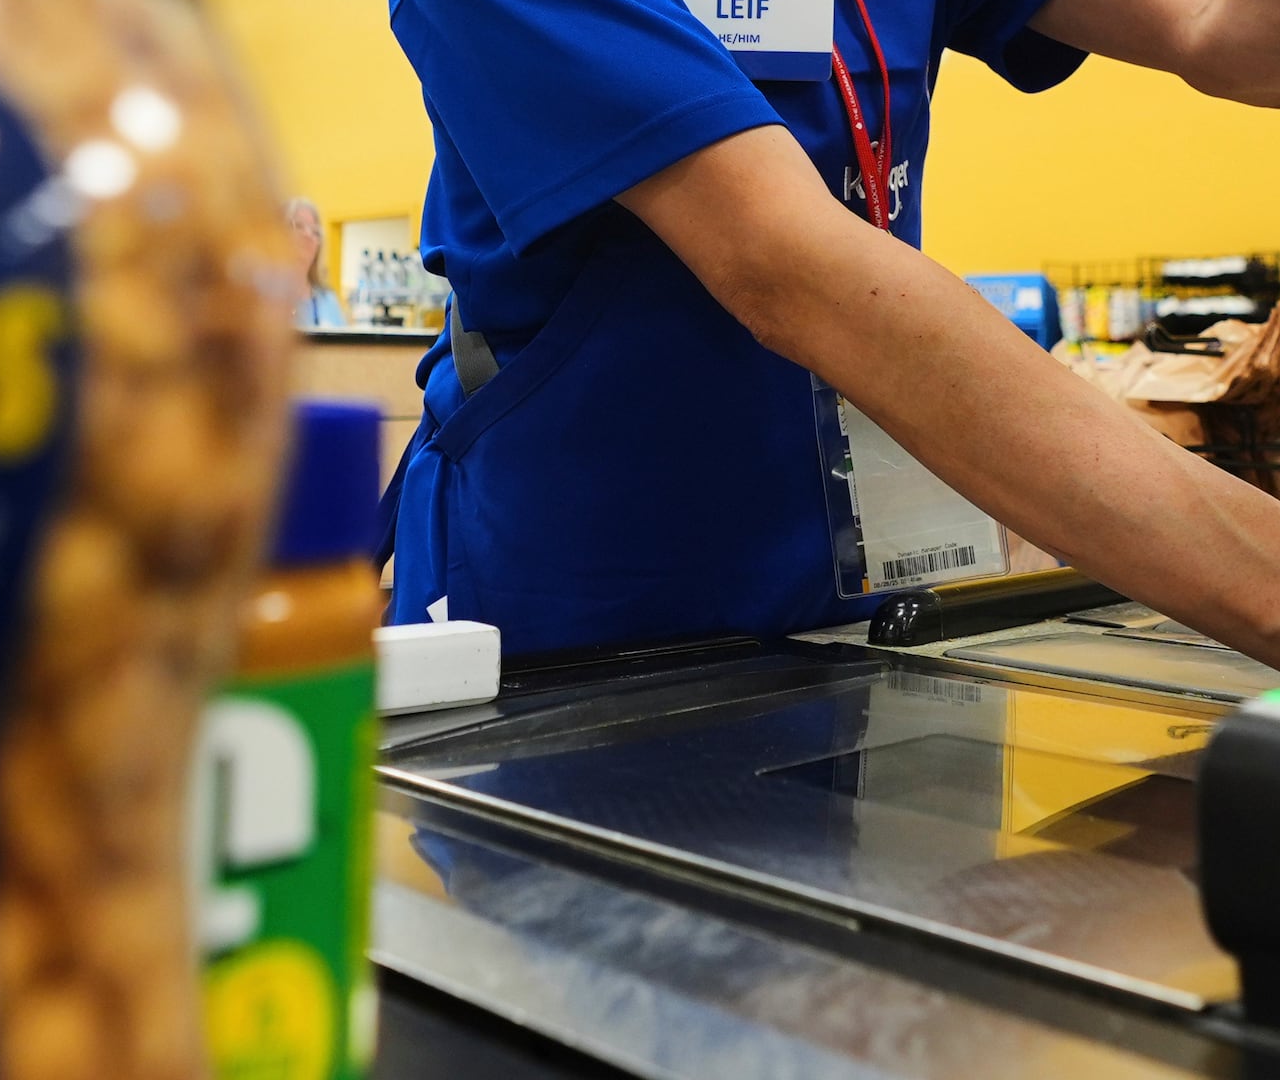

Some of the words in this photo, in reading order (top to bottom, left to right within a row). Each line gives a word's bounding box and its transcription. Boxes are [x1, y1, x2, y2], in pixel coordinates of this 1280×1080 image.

[718, 33, 761, 44] HE/HIM
[844, 141, 909, 221] Kger
[869, 174, 880, 204] SOCIETY
[920, 545, 942, 553] Manager
